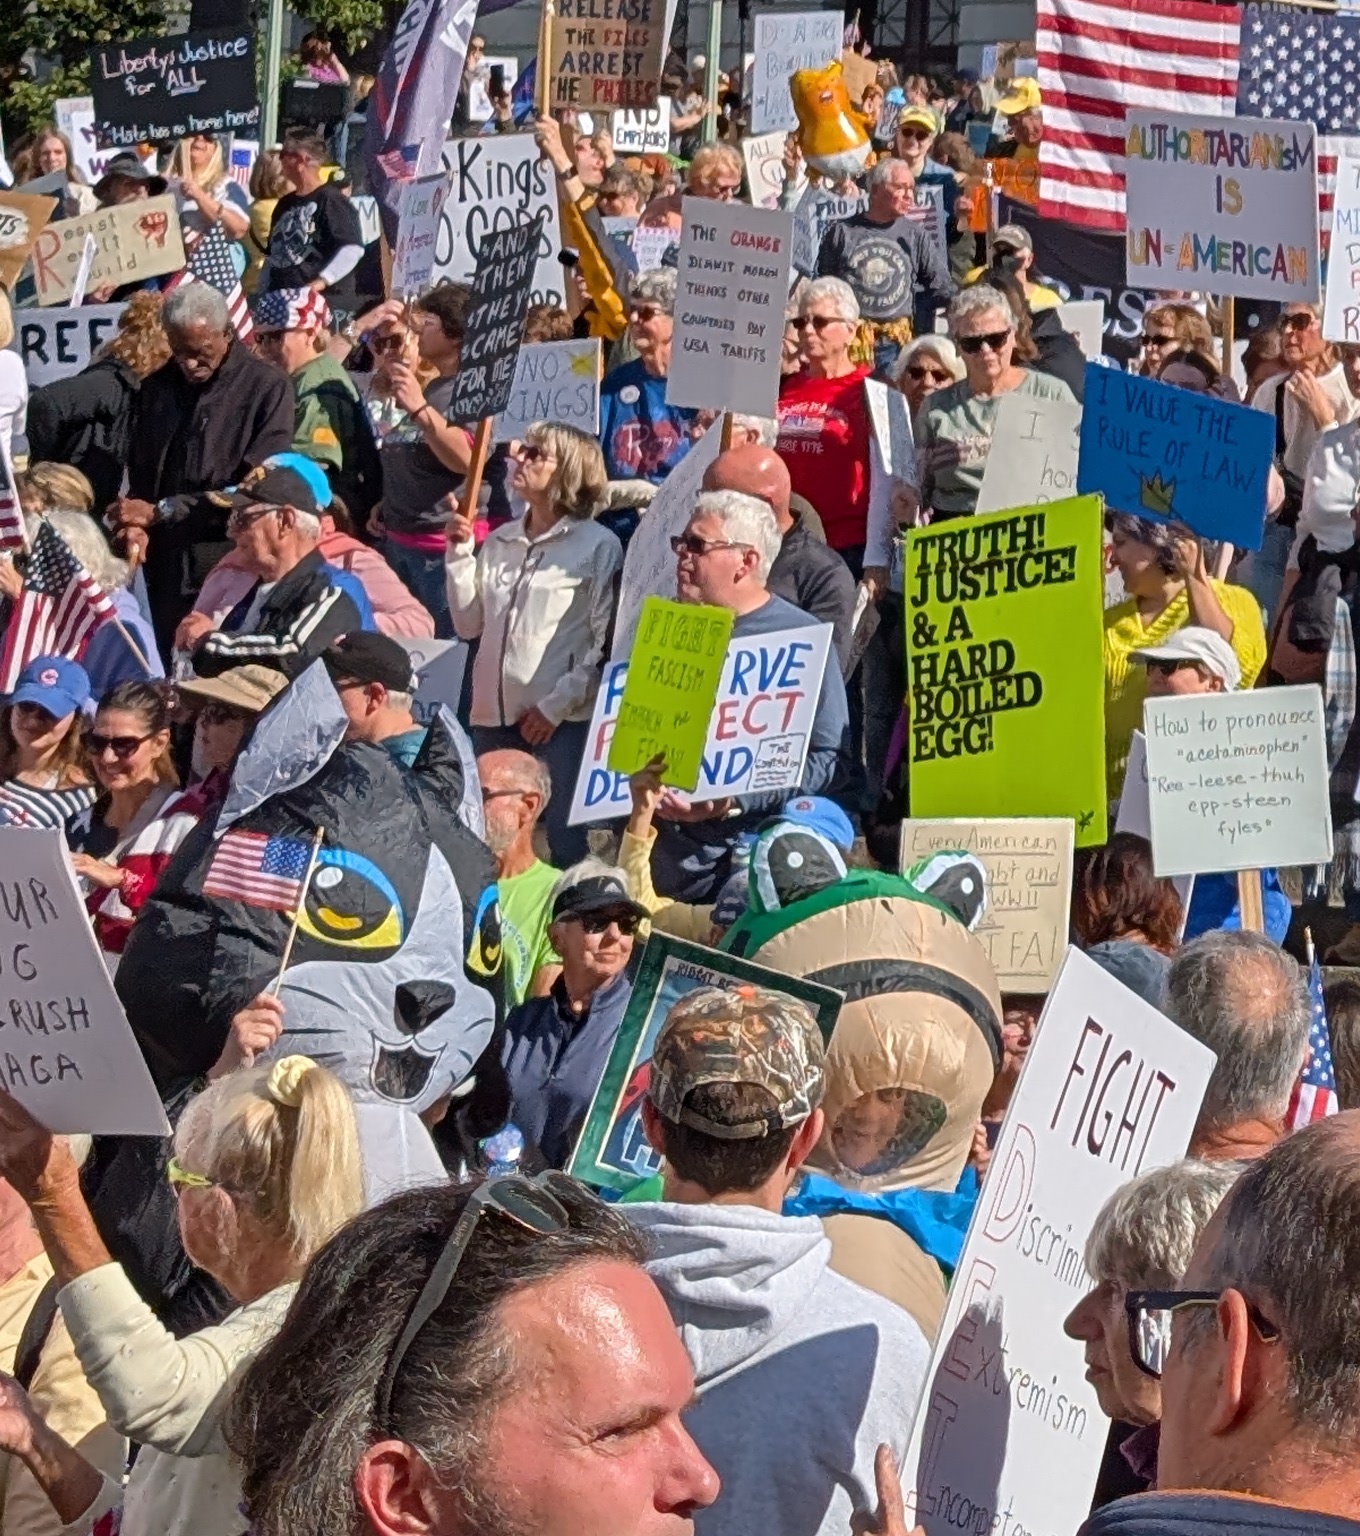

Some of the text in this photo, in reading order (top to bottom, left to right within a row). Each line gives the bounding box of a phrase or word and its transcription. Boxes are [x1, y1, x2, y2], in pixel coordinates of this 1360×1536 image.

[179, 36, 248, 64] Justice
[565, 27, 649, 47] THE FILES
[124, 65, 207, 97] for ALL
[558, 50, 645, 78] ARREST
[456, 140, 547, 209] Kings
[1215, 174, 1244, 215] IS
[690, 223, 782, 253] THE ORANGE
[478, 259, 528, 294] THEN
[685, 281, 728, 299] THINKS
[475, 290, 527, 330] THEY
[456, 367, 486, 398] FOR
[520, 351, 559, 383] NO
[1097, 373, 1239, 447] I VALUE THE
[1098, 415, 1258, 493] RULE OF LAW
[912, 512, 1047, 571] TRUTH!
[910, 545, 1078, 608] JUSTICE!
[643, 608, 726, 658] FIGHT
[912, 604, 974, 650] & A
[648, 655, 706, 694] FASCISM
[911, 638, 1016, 689] HARD
[912, 670, 1043, 726] BOILED
[912, 714, 994, 763] EGG!
[1154, 709, 1316, 745] How to pronounce
[966, 824, 1058, 851] American
[1024, 862, 1061, 885] and
[990, 890, 1039, 906] WWII
[1050, 1015, 1177, 1177] FIGHT
